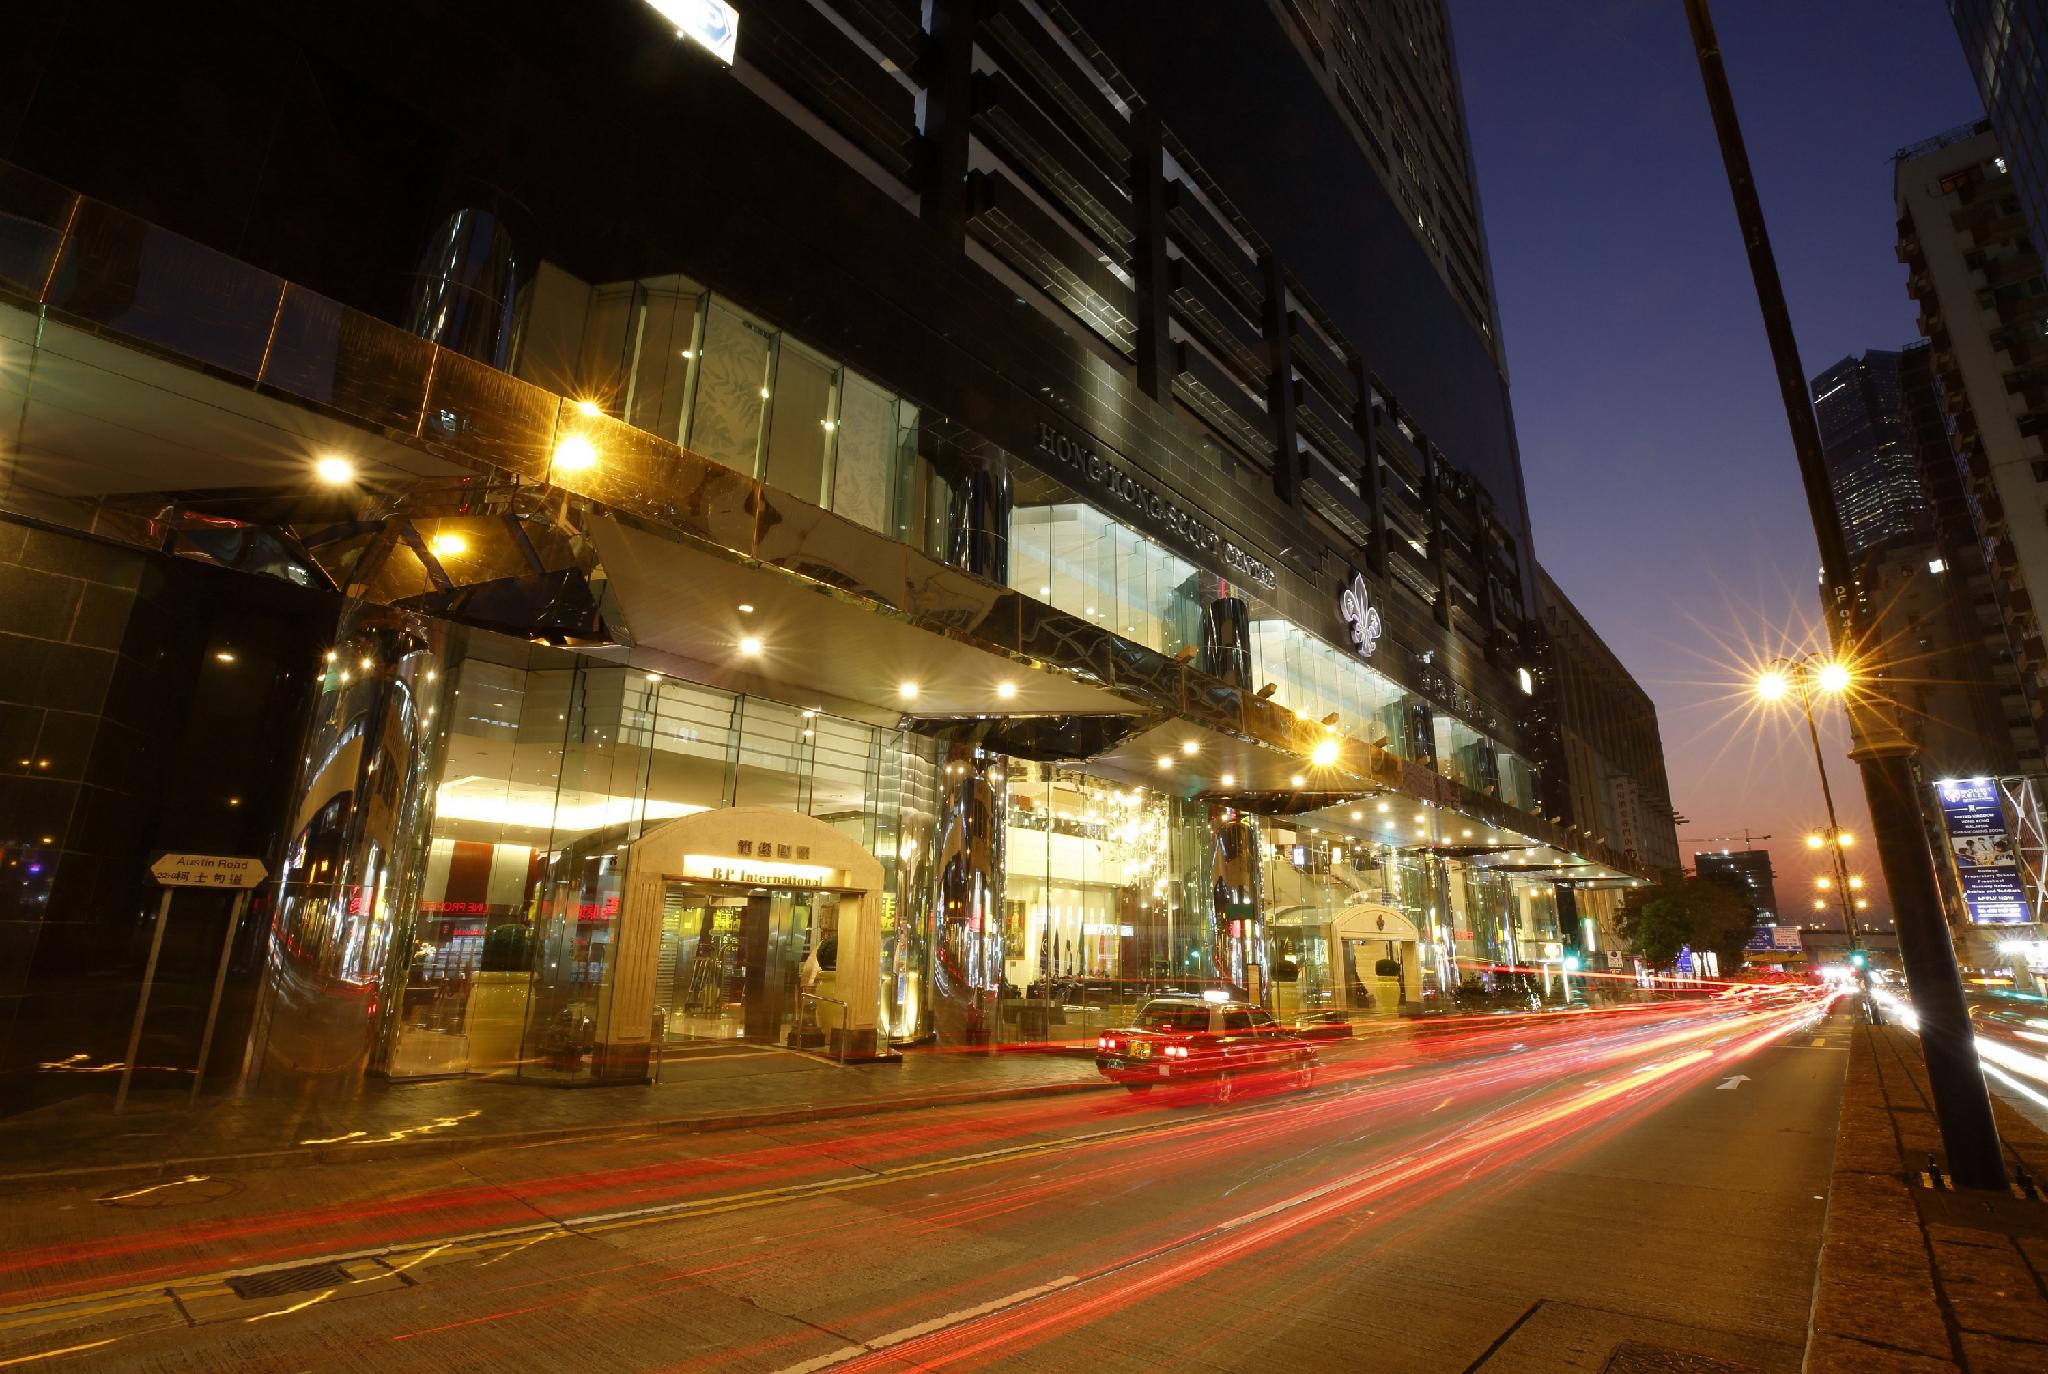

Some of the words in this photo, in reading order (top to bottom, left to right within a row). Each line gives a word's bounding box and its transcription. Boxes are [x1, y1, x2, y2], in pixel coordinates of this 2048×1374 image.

[1039, 421, 1100, 480] HONG
[1167, 505, 1220, 555] SCOUT
[176, 857, 214, 867] Austin
[217, 859, 248, 869] Road
[740, 869, 823, 887] International
